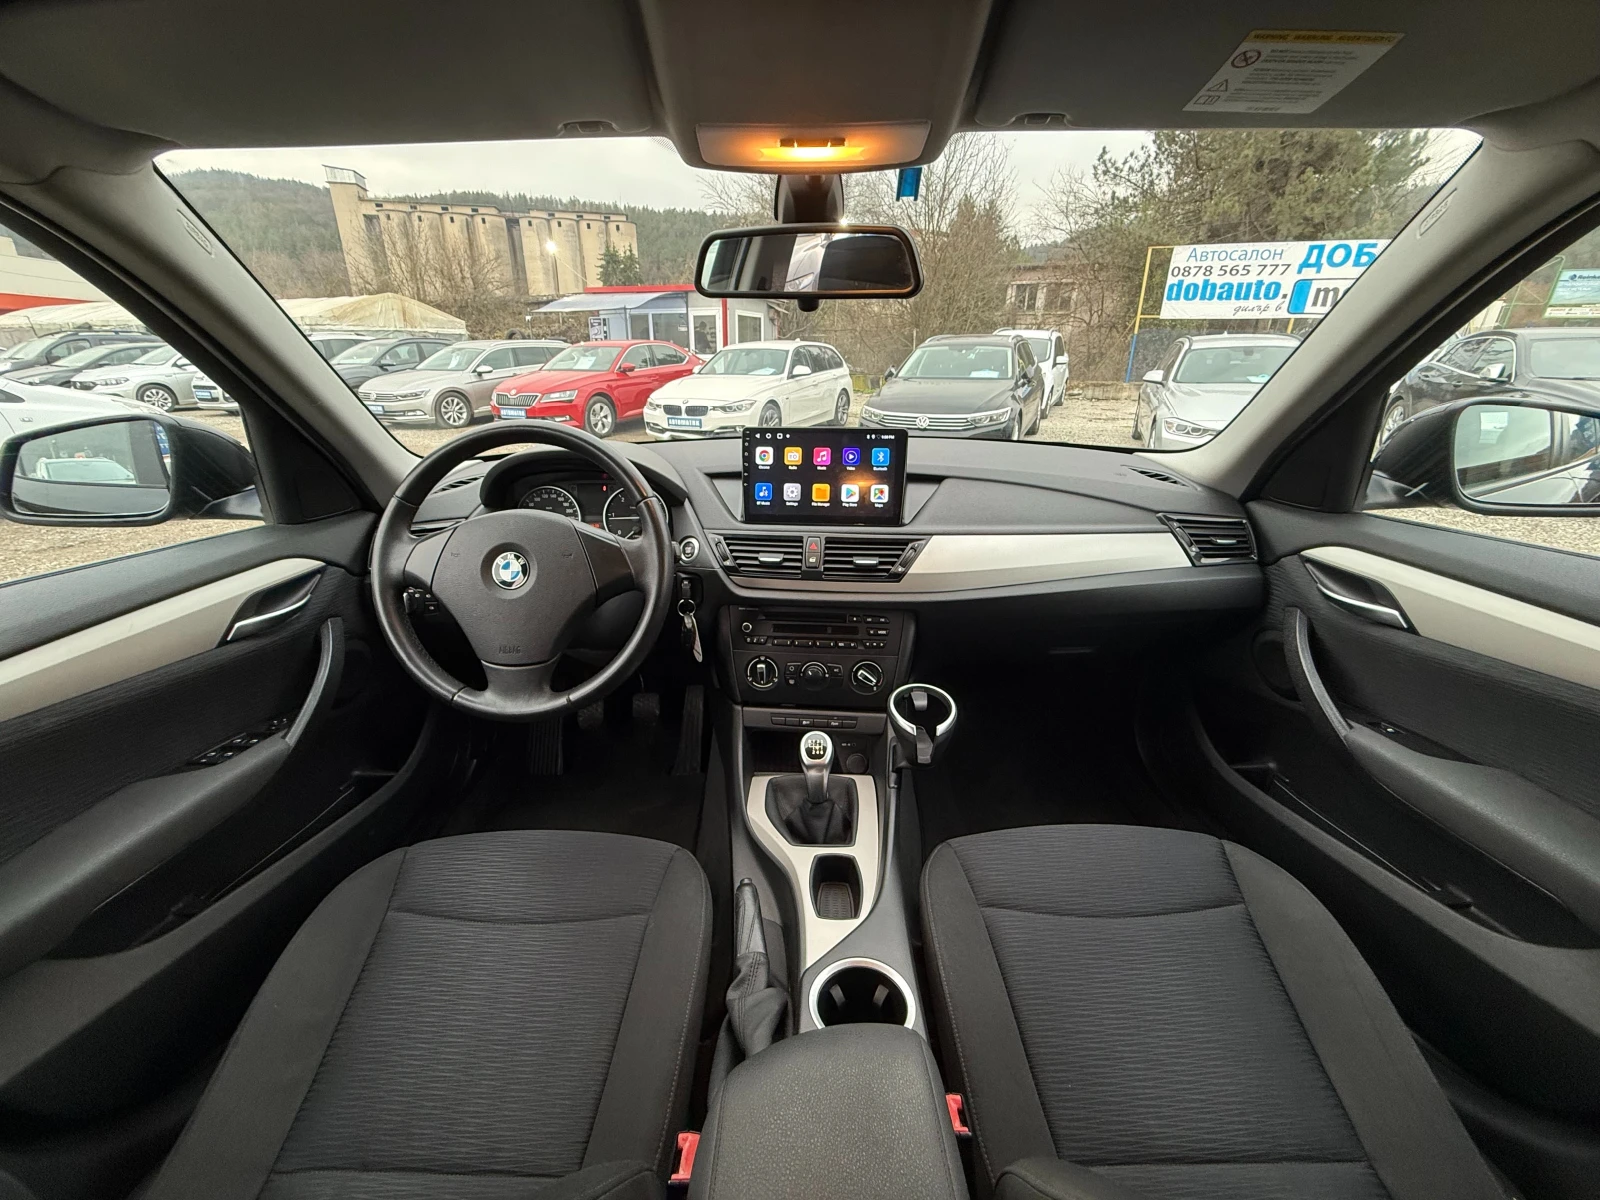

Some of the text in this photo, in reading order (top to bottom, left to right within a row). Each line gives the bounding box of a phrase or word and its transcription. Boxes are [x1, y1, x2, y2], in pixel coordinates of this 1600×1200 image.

[1186, 247, 1284, 262] Автосалон
[1297, 243, 1378, 274] ДОБ
[1171, 263, 1292, 277] 0878 565 777
[497, 553, 526, 565] BMW
